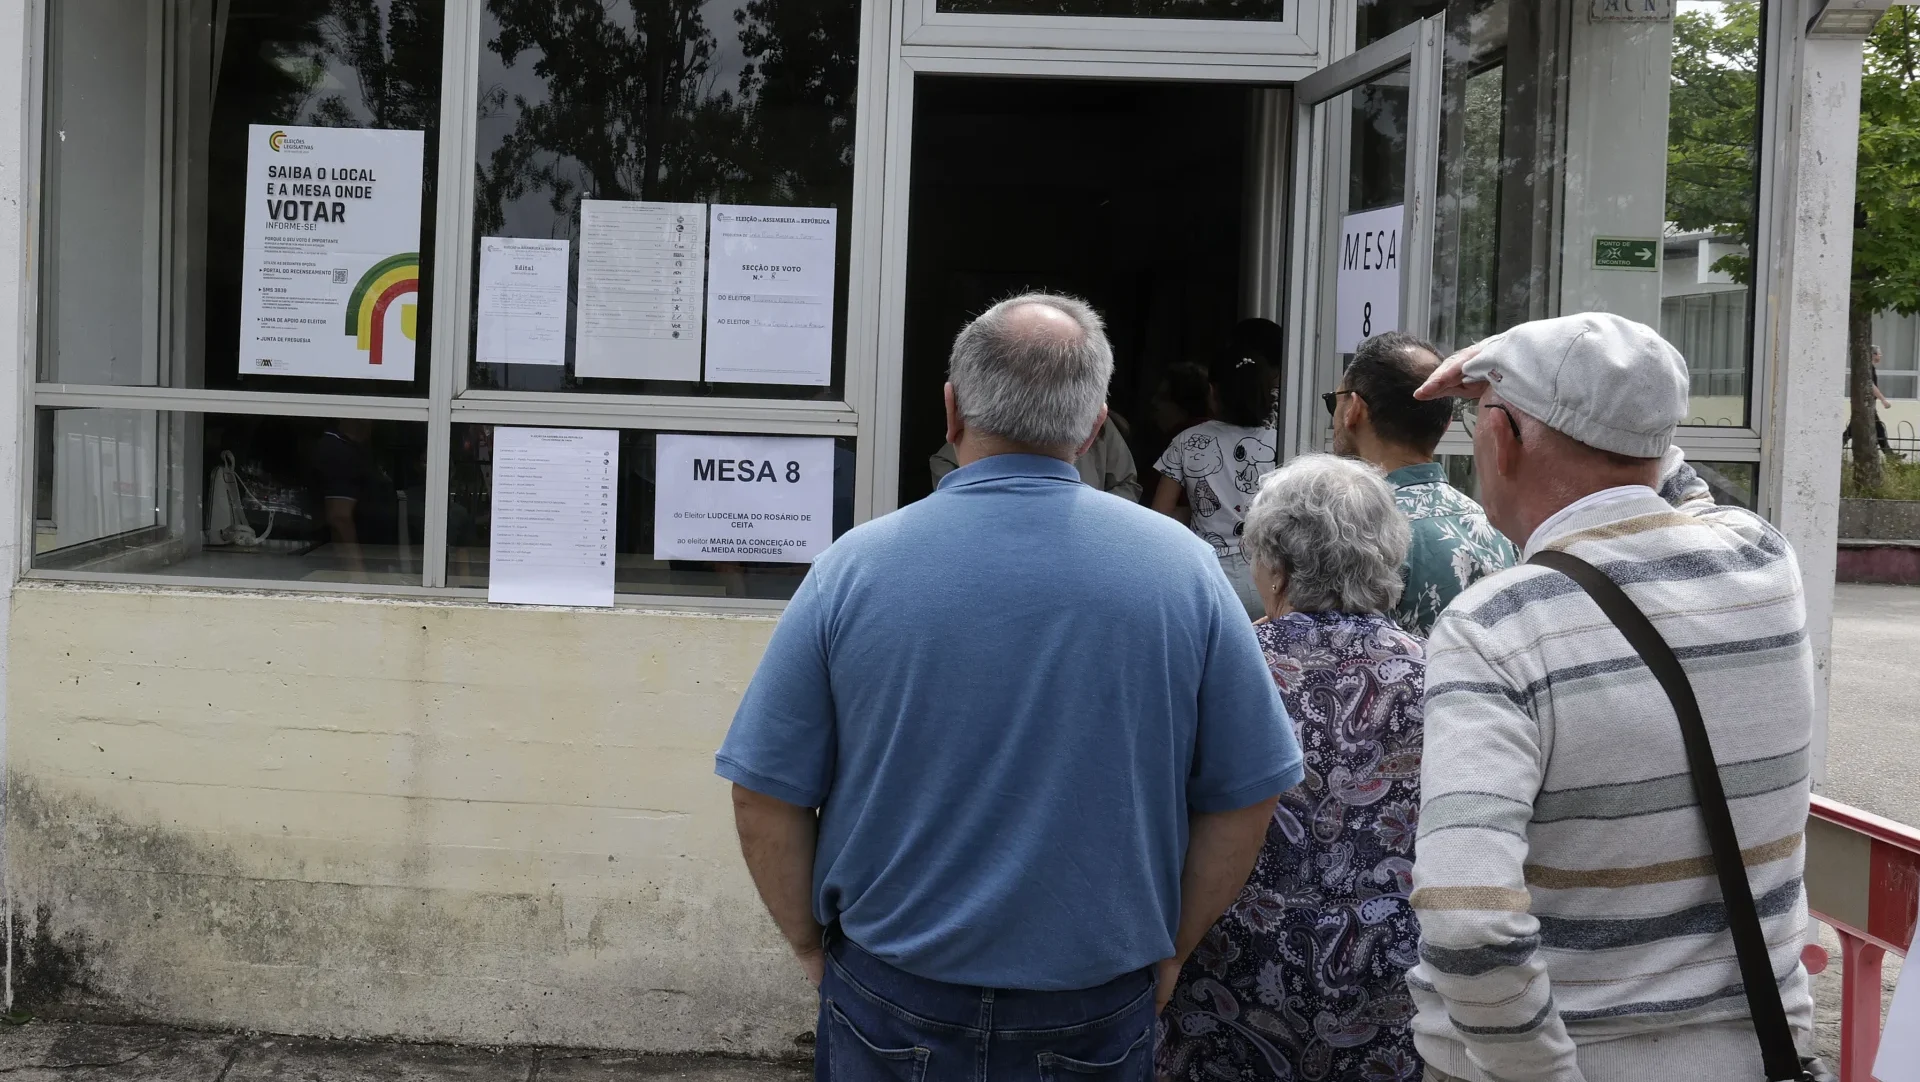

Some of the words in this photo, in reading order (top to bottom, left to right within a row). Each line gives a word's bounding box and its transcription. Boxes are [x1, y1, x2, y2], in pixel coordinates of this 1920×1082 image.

[268, 166, 312, 180] SAIBA
[317, 168, 326, 180] O
[332, 168, 376, 182] LOCAL
[267, 182, 274, 195] E
[278, 183, 288, 196] A
[292, 184, 331, 198] MESA
[335, 185, 372, 199] ONDE
[267, 199, 346, 223] VOTAR
[265, 222, 317, 231] INFORME-SE!
[1343, 229, 1396, 270] MESA
[742, 264, 769, 273] SECÇÃO
[1362, 302, 1372, 337] 8
[694, 458, 777, 482] MESA
[785, 461, 800, 484] 8
[764, 513, 799, 521] ROSÁRIO
[749, 538, 794, 548] CONCEIÇÃO
